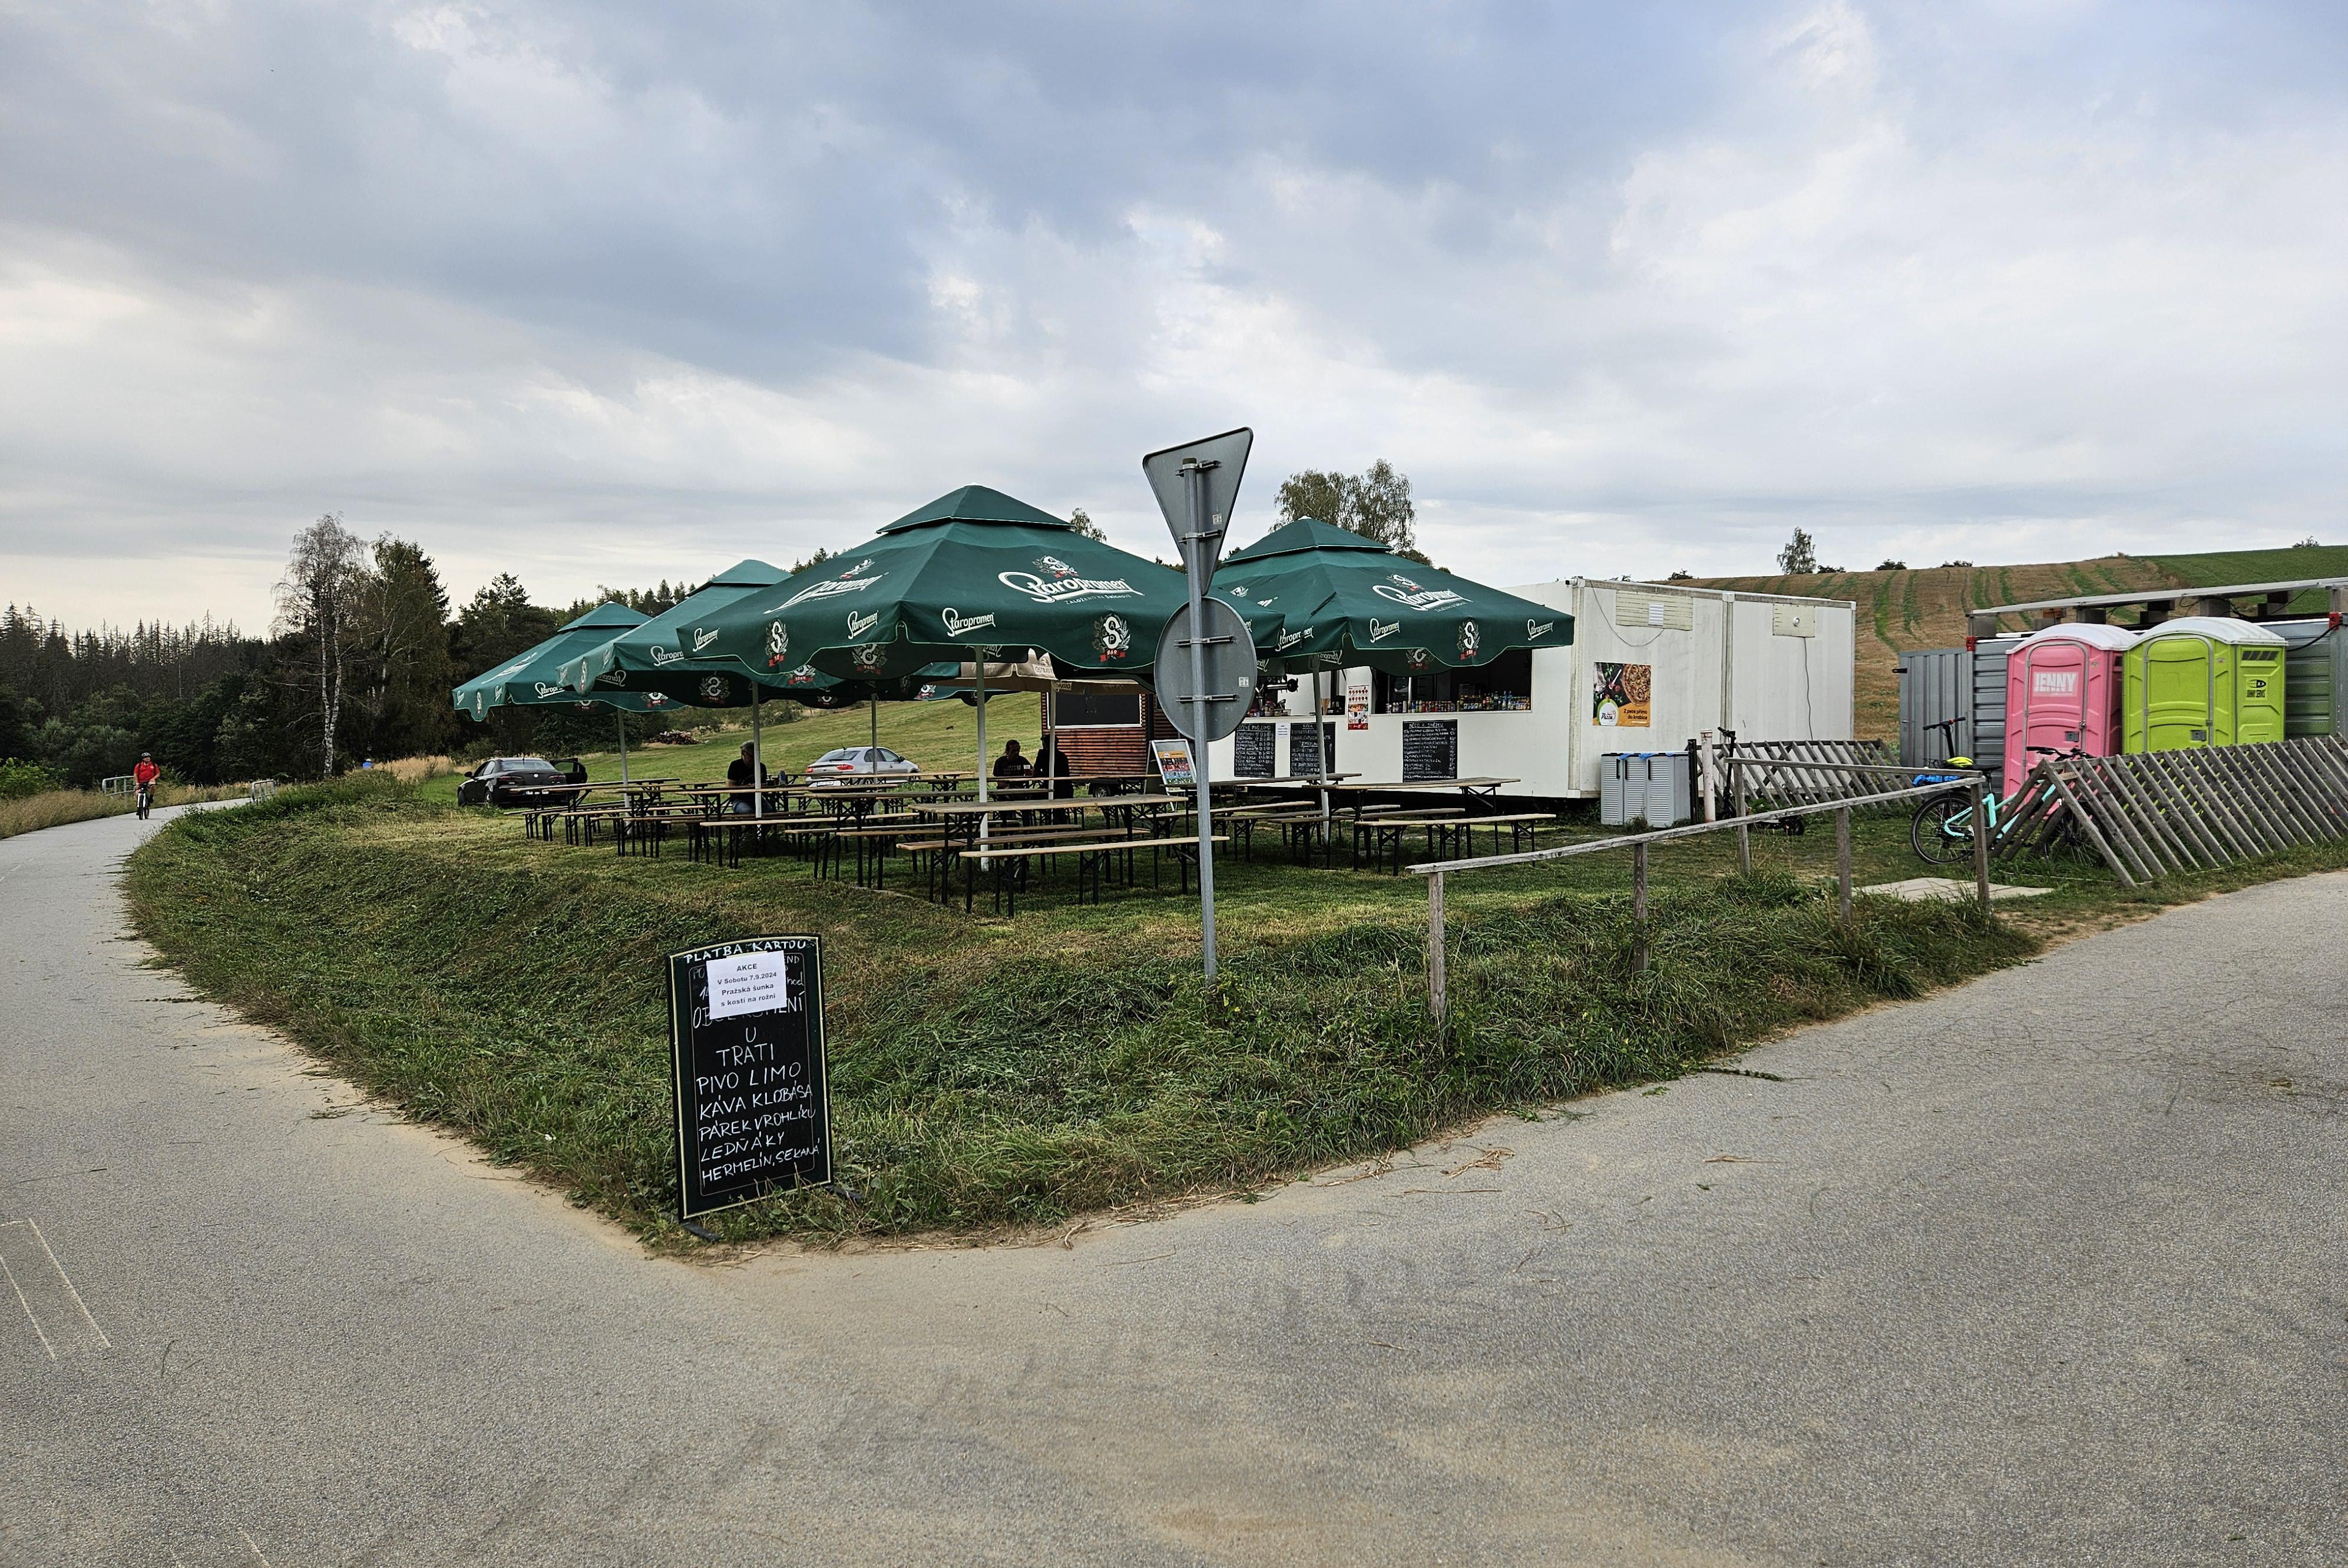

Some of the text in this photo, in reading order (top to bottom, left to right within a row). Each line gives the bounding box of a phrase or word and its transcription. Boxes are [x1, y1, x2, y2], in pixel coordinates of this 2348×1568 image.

[998, 571, 1145, 603] Staropramen
[848, 610, 878, 640] Staropramen
[942, 607, 996, 637] Staropramen
[1370, 618, 1400, 643] Staropramen
[2034, 673, 2076, 692] JENNY
[684, 940, 806, 964] PLATBA KARTOU
[749, 972, 777, 980] 7.9.2024
[722, 986, 750, 995] Pražská
[746, 1027, 756, 1043] U
[716, 1043, 774, 1067] TRATI
[696, 1062, 801, 1096] PIVO LIMO
[700, 1080, 813, 1120] KÁVA KLOBÁSA
[699, 1120, 752, 1142] PÁREK
